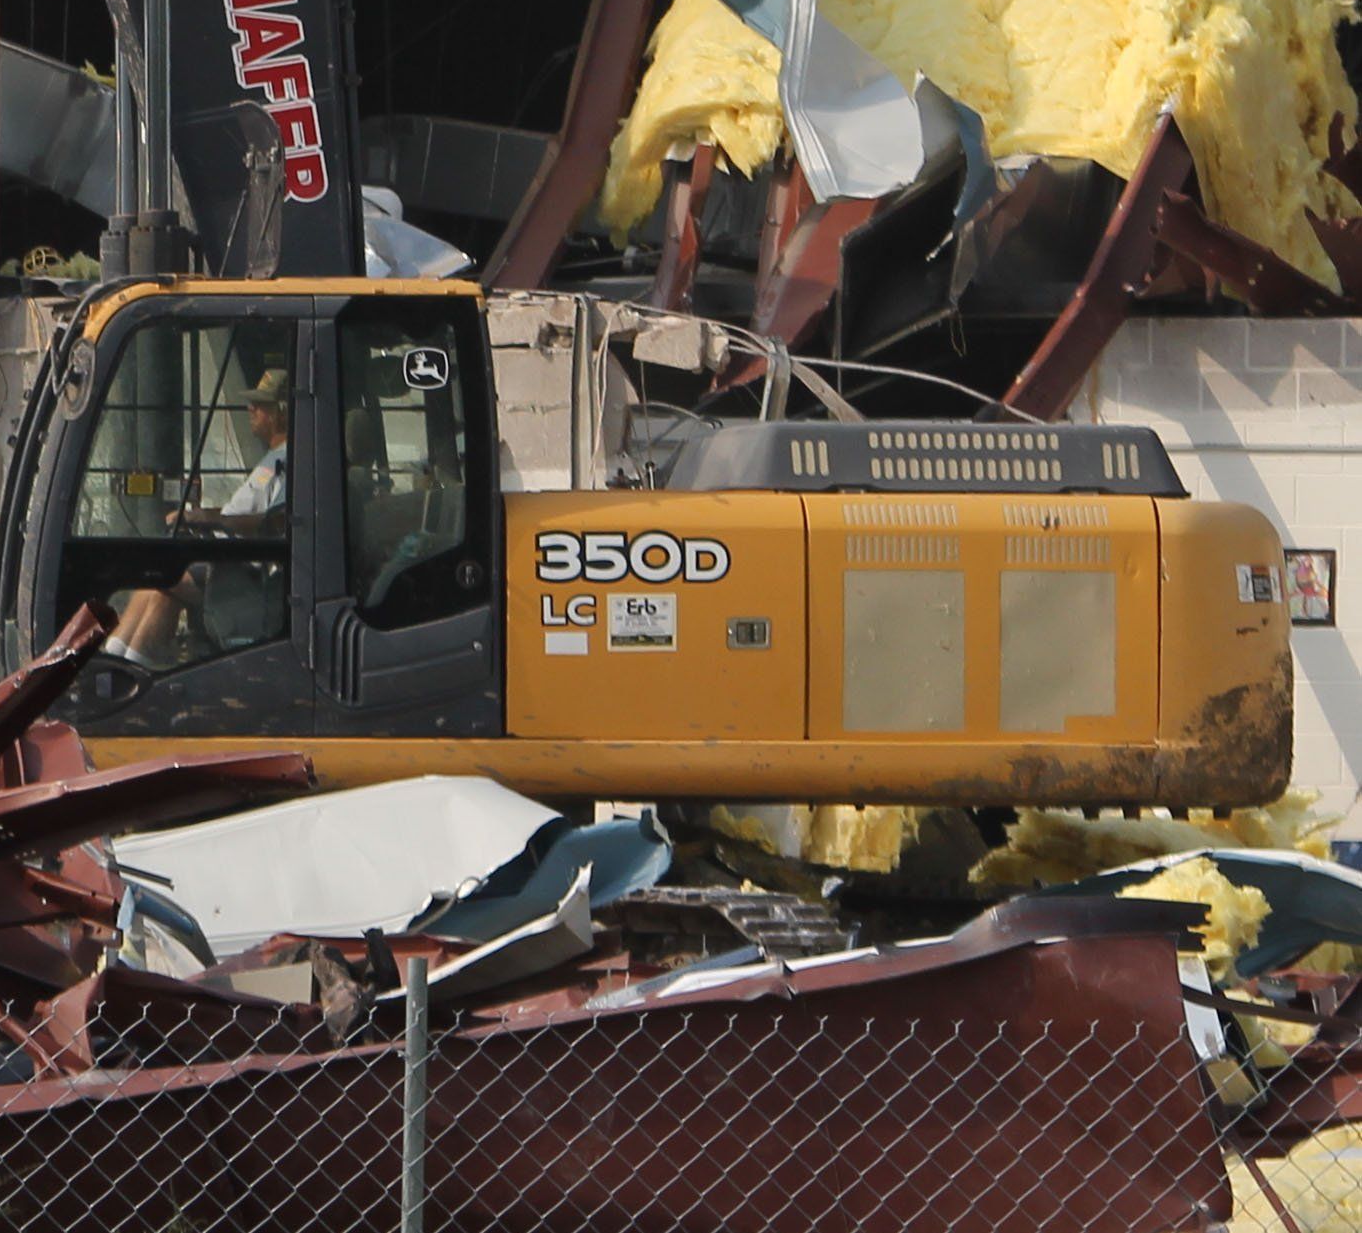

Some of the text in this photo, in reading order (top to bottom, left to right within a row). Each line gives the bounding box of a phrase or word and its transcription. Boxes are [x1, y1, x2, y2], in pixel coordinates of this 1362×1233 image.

[535, 530, 731, 583] 350D
[541, 594, 597, 627] LC
[627, 597, 657, 616] Erb
